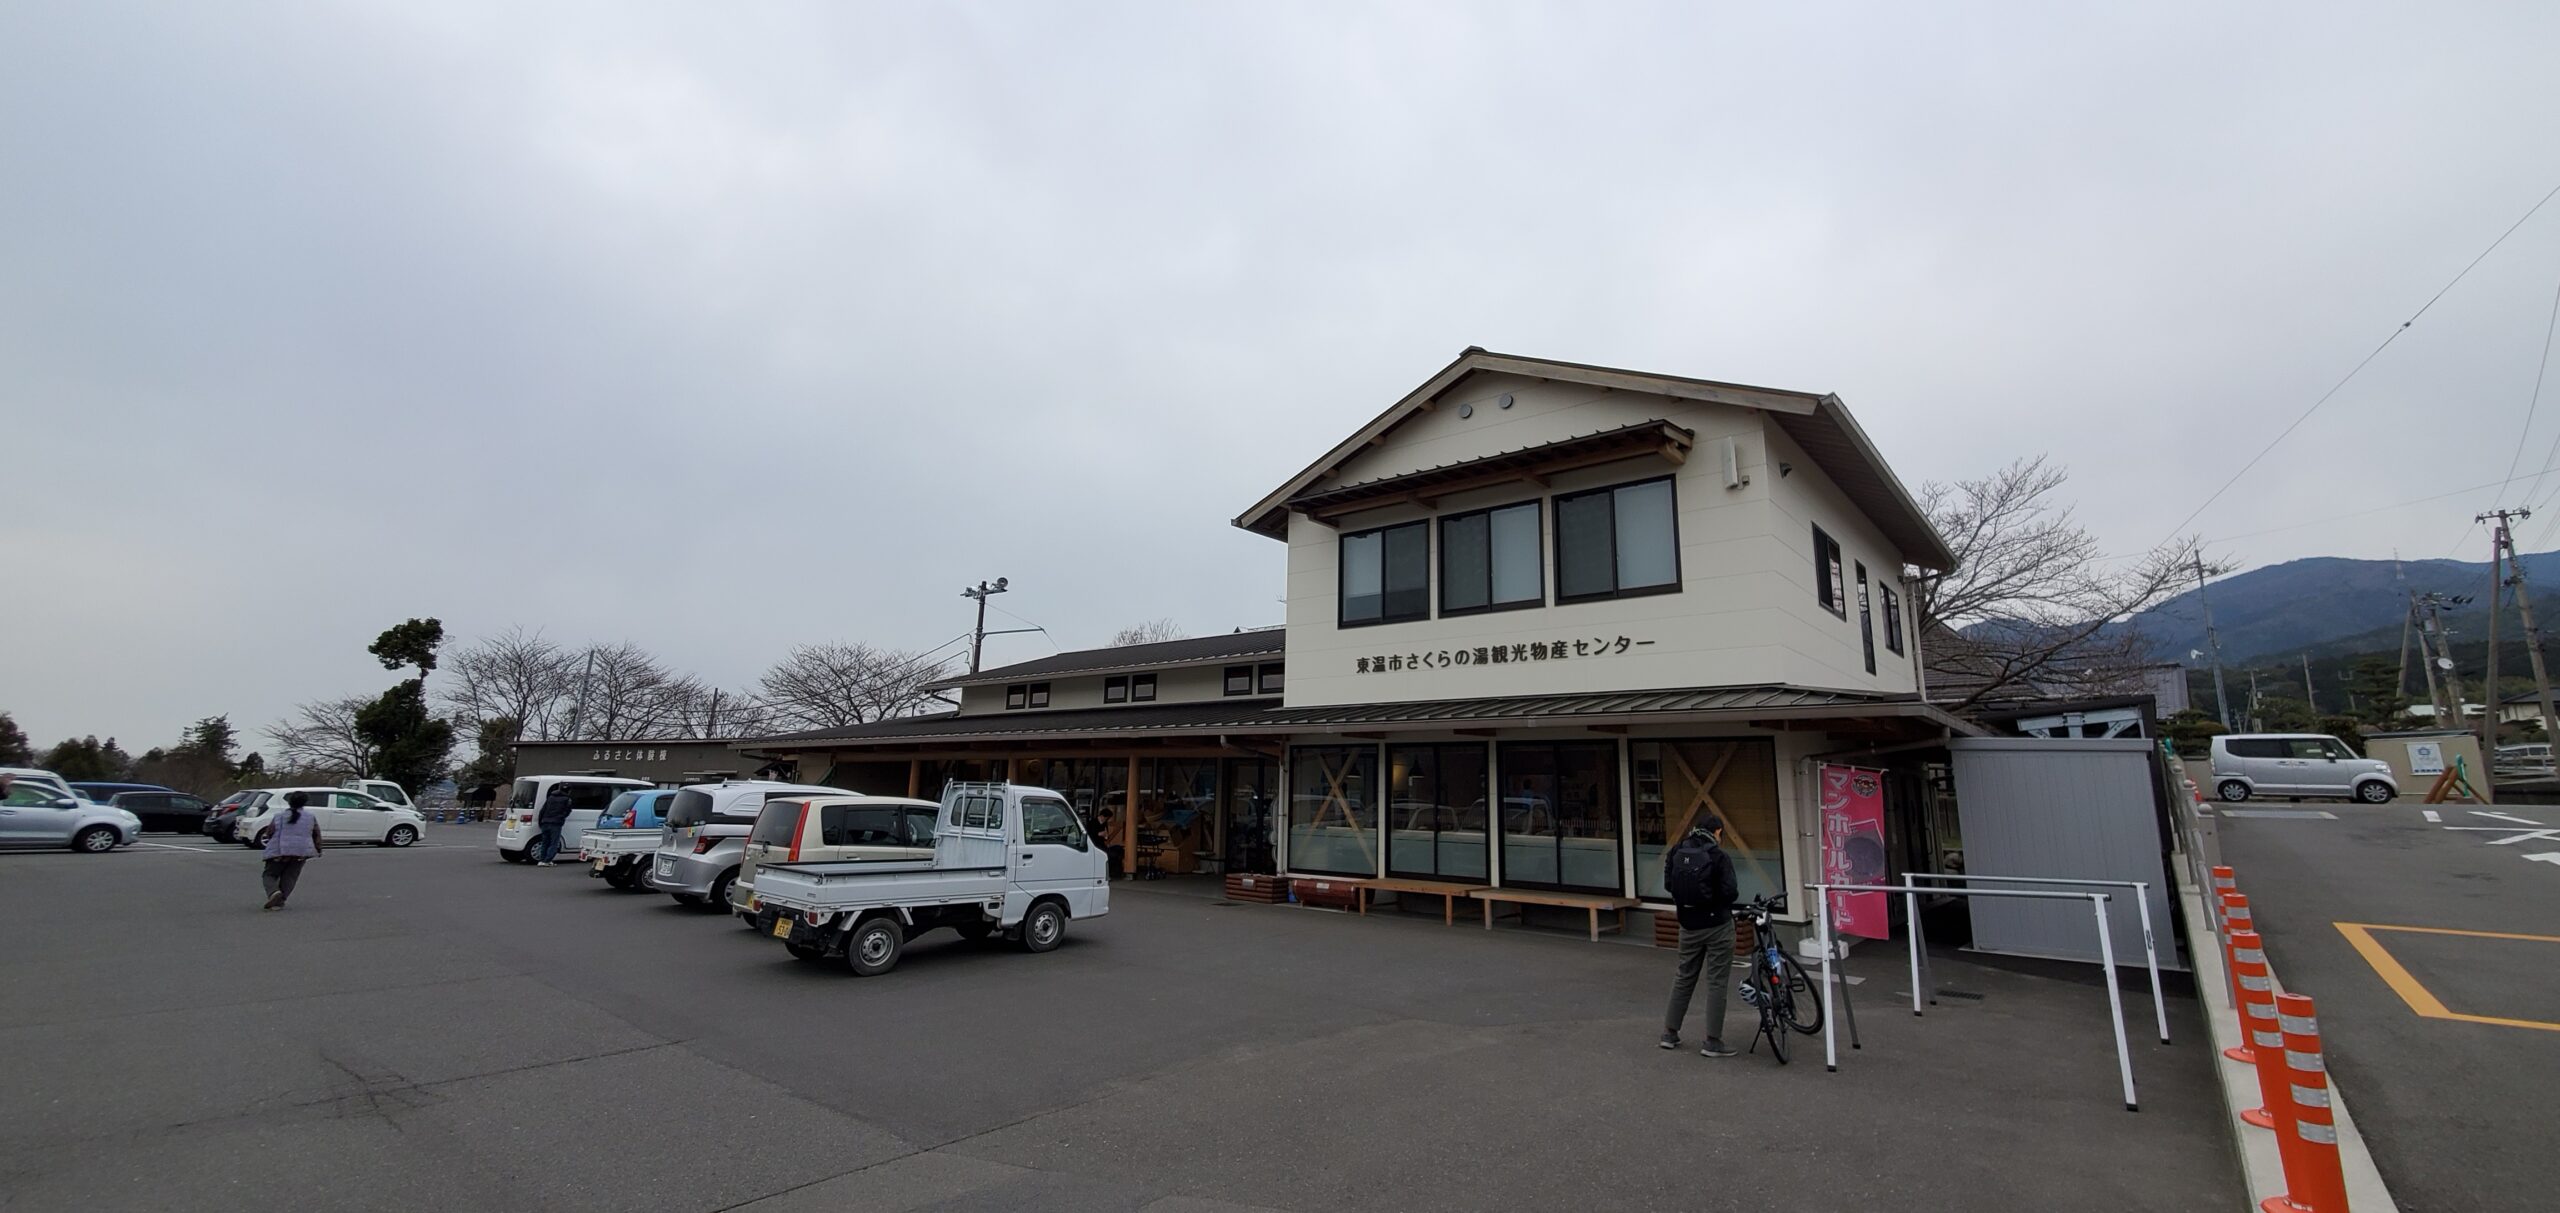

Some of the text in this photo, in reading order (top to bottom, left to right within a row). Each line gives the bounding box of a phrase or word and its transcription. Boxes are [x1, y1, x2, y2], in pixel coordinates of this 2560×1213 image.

[1356, 635, 1655, 674] 東温市さくらの湯観光物産センター
[1826, 771, 1853, 929] マンホールカード
